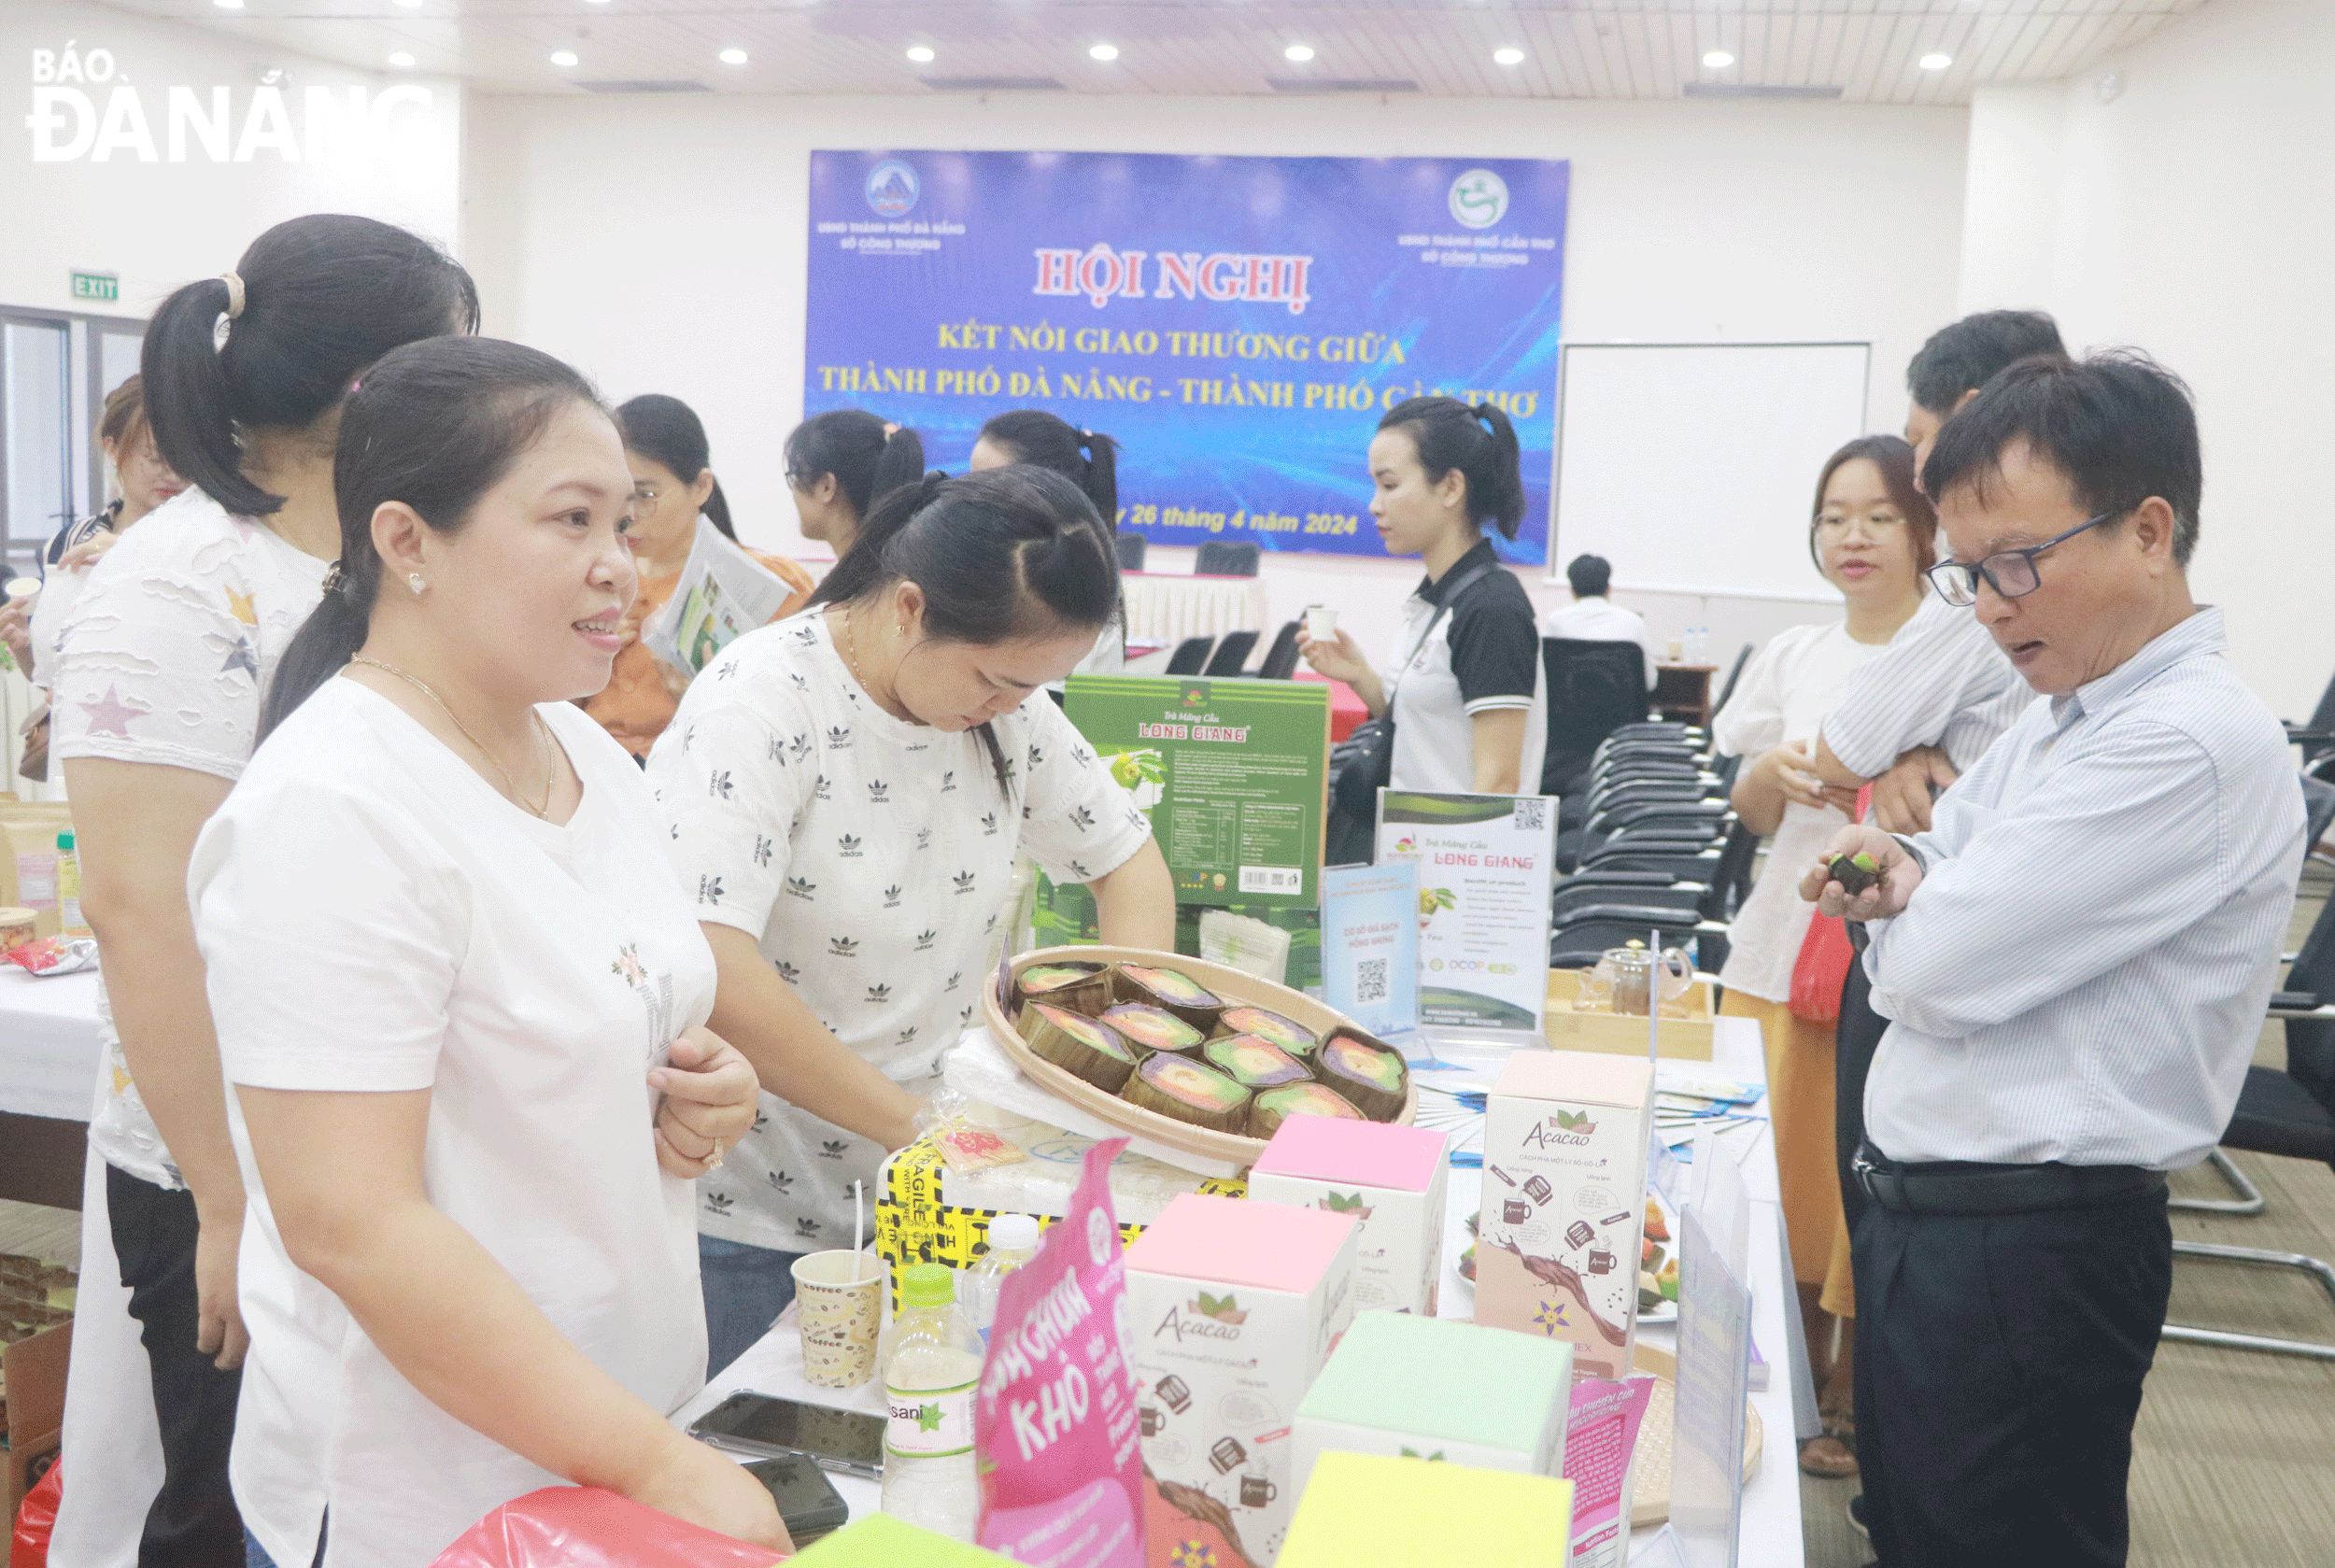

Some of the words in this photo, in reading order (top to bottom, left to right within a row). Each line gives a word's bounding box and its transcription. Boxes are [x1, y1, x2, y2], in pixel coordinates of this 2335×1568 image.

[75, 276, 117, 298] EXIT
[1033, 243, 1148, 309] HỘI
[1153, 252, 1313, 316] NGHỊ
[938, 318, 1002, 350] KẾT
[1009, 318, 1067, 352] NỐI
[1074, 328, 1160, 355] GIAO
[1166, 330, 1310, 361] THƯƠNG
[1319, 331, 1406, 364] GIỮA
[818, 360, 927, 393] THÀNH
[937, 364, 1001, 397] PHỐ
[1009, 365, 1052, 398] ĐÀ
[1060, 367, 1153, 402] NẴNG
[1178, 373, 1294, 408] THÀNH
[1305, 377, 1375, 411] PHỐ
[1131, 504, 1157, 525] 26
[1163, 506, 1225, 533] tháng
[1231, 510, 1245, 529] 4
[1250, 512, 1299, 532] năm
[1305, 514, 1358, 535] 2024
[1139, 722, 1187, 740] LONG
[1192, 725, 1247, 742] GIANG
[1435, 852, 1479, 867] LONG
[1484, 855, 1534, 869] GIANG
[1522, 1121, 1590, 1150] Acacao
[913, 1152, 937, 1222] FRAGILE
[1153, 1305, 1240, 1343] Acacao
